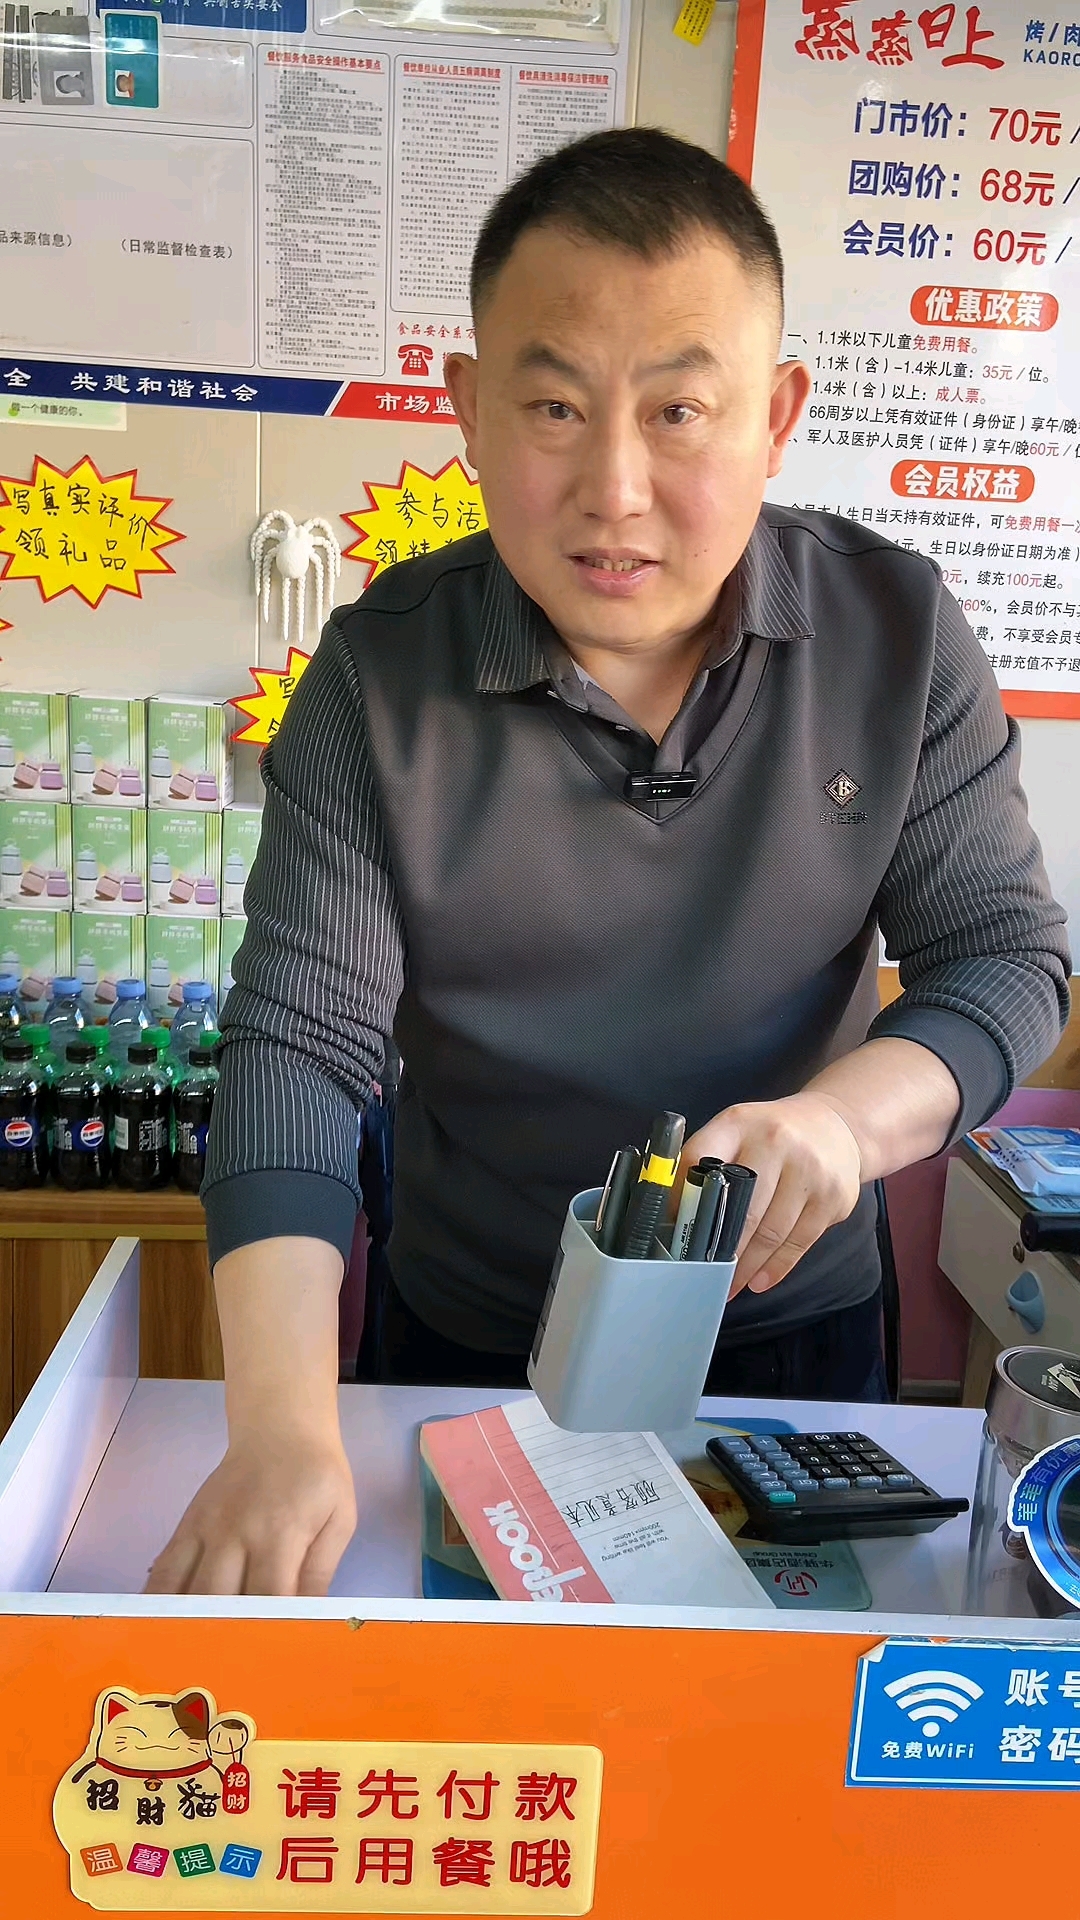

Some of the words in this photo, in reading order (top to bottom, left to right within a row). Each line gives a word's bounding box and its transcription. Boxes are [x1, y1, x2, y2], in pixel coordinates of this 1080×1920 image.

[794, 0, 1005, 70] 蒸蒸日上
[925, 288, 1043, 327] 优惠政策
[70, 372, 259, 402] 共建和谐社会
[809, 405, 1080, 435] 66周岁以上凭有效证件（身份证）享午/晚
[904, 463, 1021, 500] 会员权益
[13, 479, 159, 551] 写真实评价
[395, 488, 482, 531] 参与活
[15, 527, 127, 571] 领礼品
[375, 538, 453, 564] 领精
[957, 597, 1080, 618] 60%，会员价不与
[970, 626, 1080, 645] 费，不享受会员
[998, 1725, 1080, 1764] 密码
[227, 1771, 247, 1810] 招财
[277, 1767, 578, 1822] 请先付款
[87, 1848, 255, 1874] 温馨提示
[276, 1837, 572, 1889] 后用餐哦
